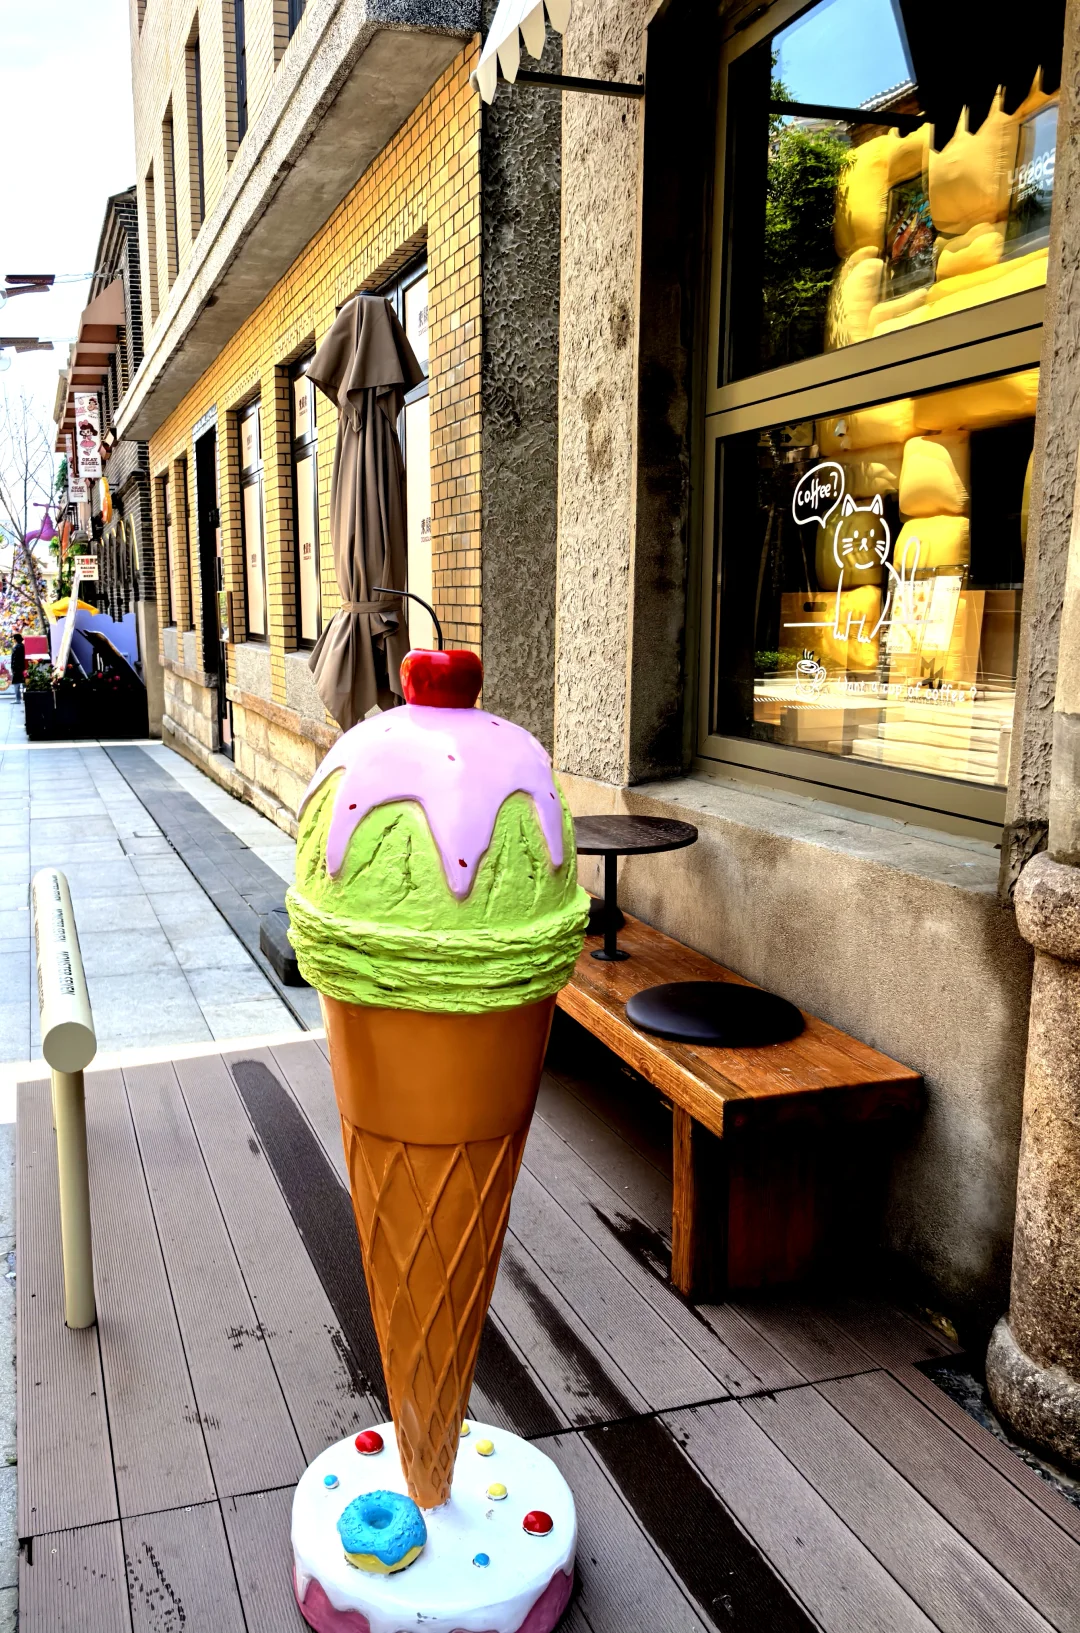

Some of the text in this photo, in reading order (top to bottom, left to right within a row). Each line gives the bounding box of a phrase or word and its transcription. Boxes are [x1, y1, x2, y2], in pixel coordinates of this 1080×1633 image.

[797, 471, 838, 510] coffee?
[908, 681, 923, 697] of
[926, 683, 965, 702] coffee
